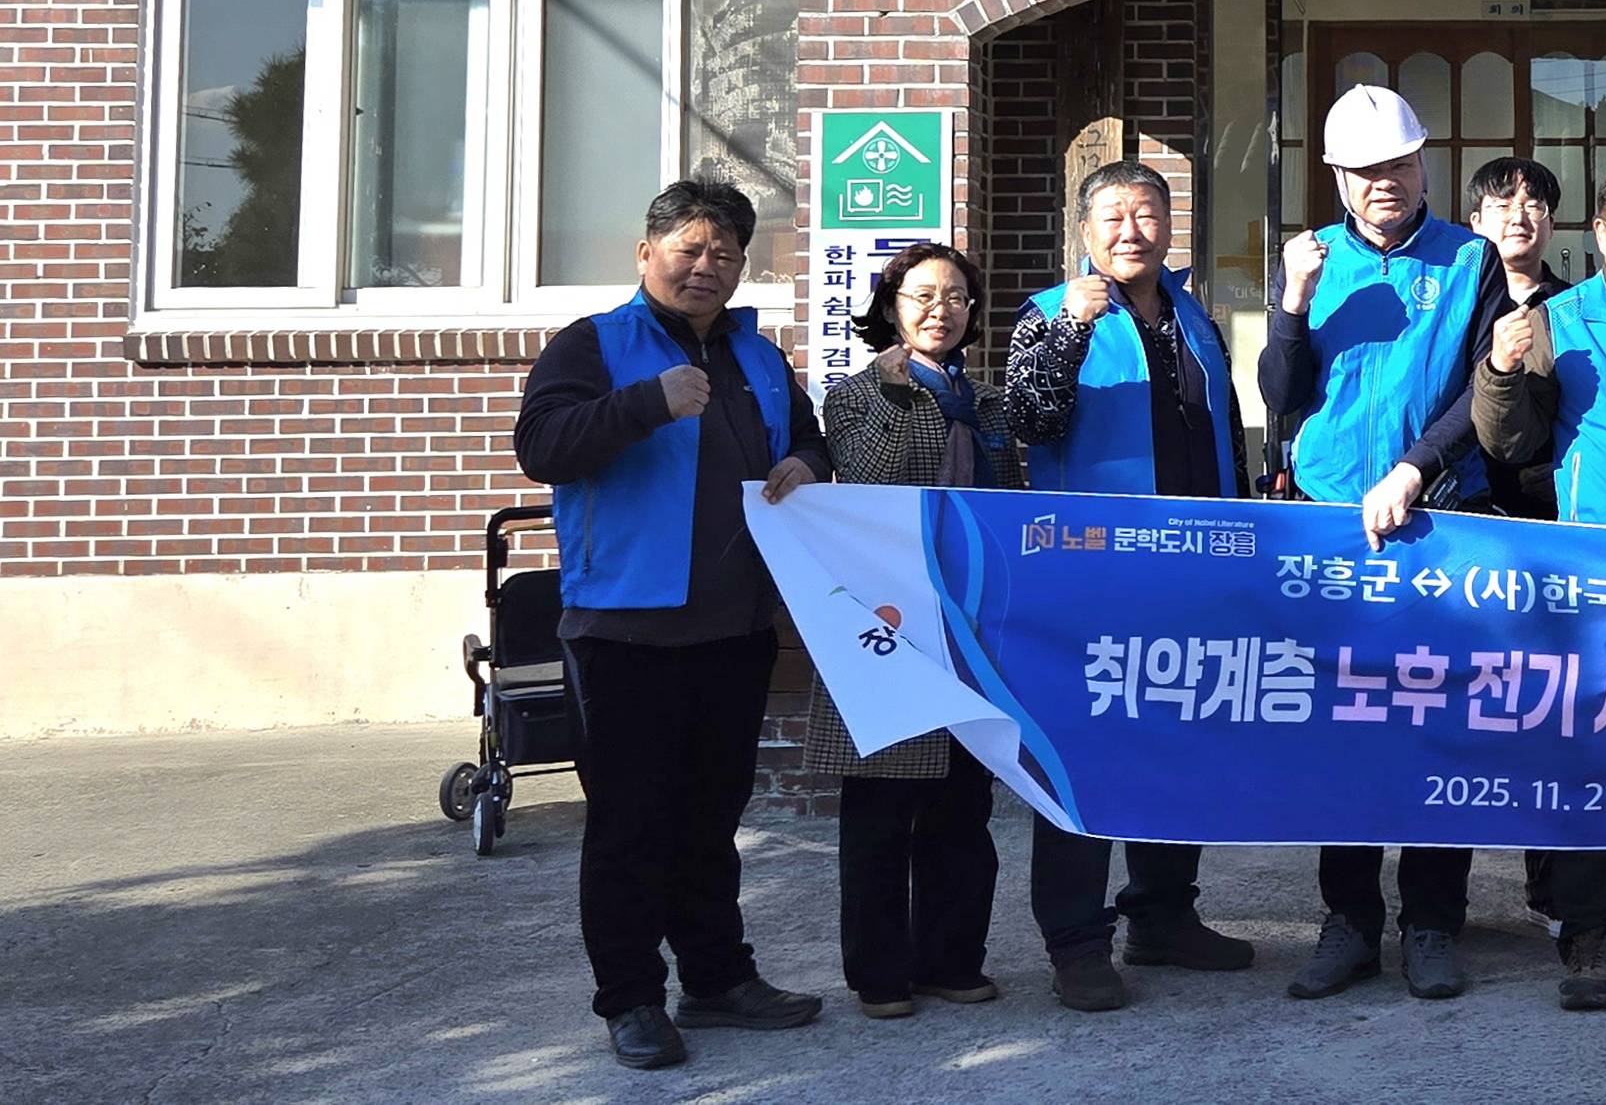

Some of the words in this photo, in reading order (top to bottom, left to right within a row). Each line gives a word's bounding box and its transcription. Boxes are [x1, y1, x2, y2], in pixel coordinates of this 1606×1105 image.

[1168, 518, 1183, 527] City
[1185, 518, 1193, 526] of
[1217, 520, 1254, 528] Literature
[1061, 526, 1107, 550] 노벨
[1114, 527, 1203, 554] 문학도시
[1209, 530, 1256, 557] 장흥
[1276, 554, 1401, 603] 장흥군
[1084, 635, 1317, 722] 취약계층
[1332, 645, 1450, 726] 노후
[1467, 650, 1580, 737] 전기
[1424, 775, 1519, 808] 2025.
[1531, 780, 1571, 811] 11.
